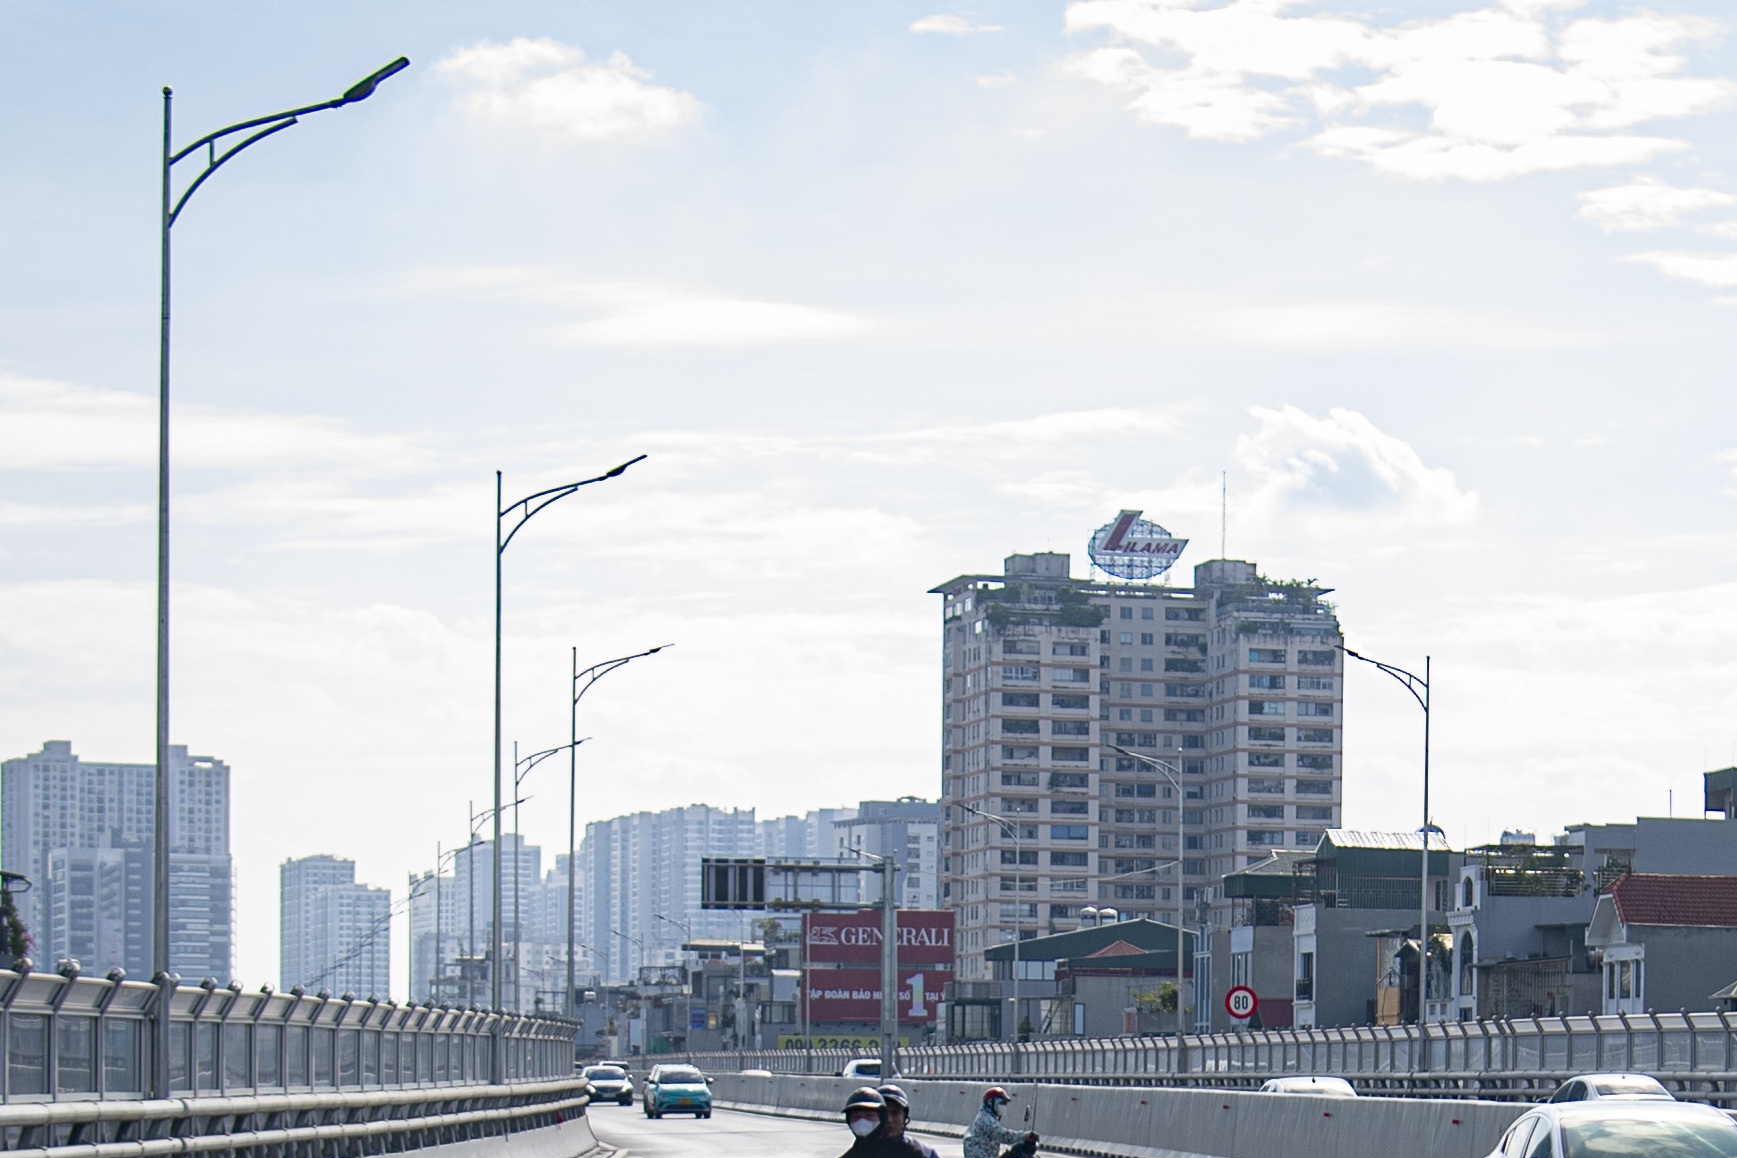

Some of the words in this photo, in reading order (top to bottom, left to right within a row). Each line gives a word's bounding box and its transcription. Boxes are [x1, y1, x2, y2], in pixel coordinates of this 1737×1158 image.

[1102, 511, 1180, 554] LILAMA
[906, 973, 928, 1016] 1
[1234, 995, 1248, 1010] 80
